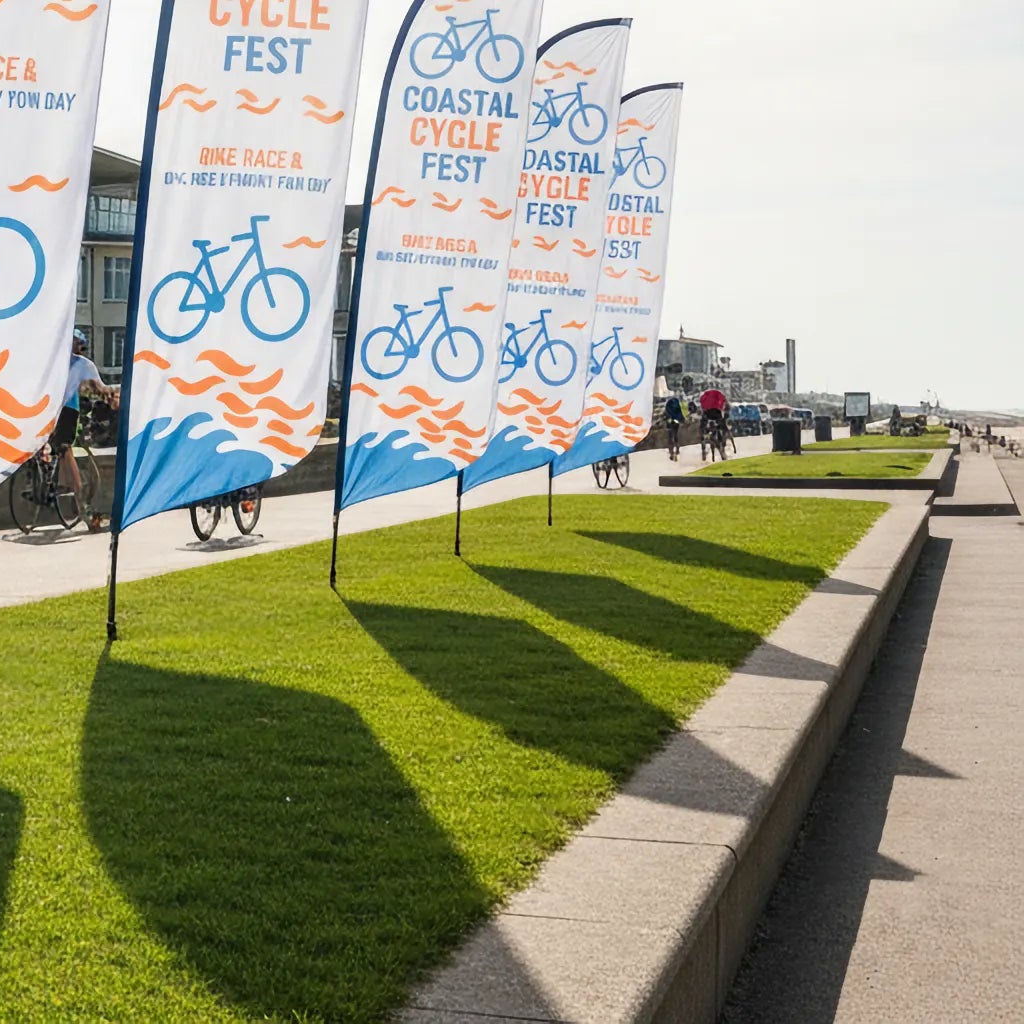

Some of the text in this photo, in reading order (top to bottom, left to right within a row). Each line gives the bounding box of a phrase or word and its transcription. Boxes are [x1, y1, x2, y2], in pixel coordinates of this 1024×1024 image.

[223, 35, 312, 74] FEST
[403, 85, 519, 119] COASTAL
[242, 148, 288, 169] RACE
[421, 152, 487, 184] FEST
[526, 202, 578, 229] FEST
